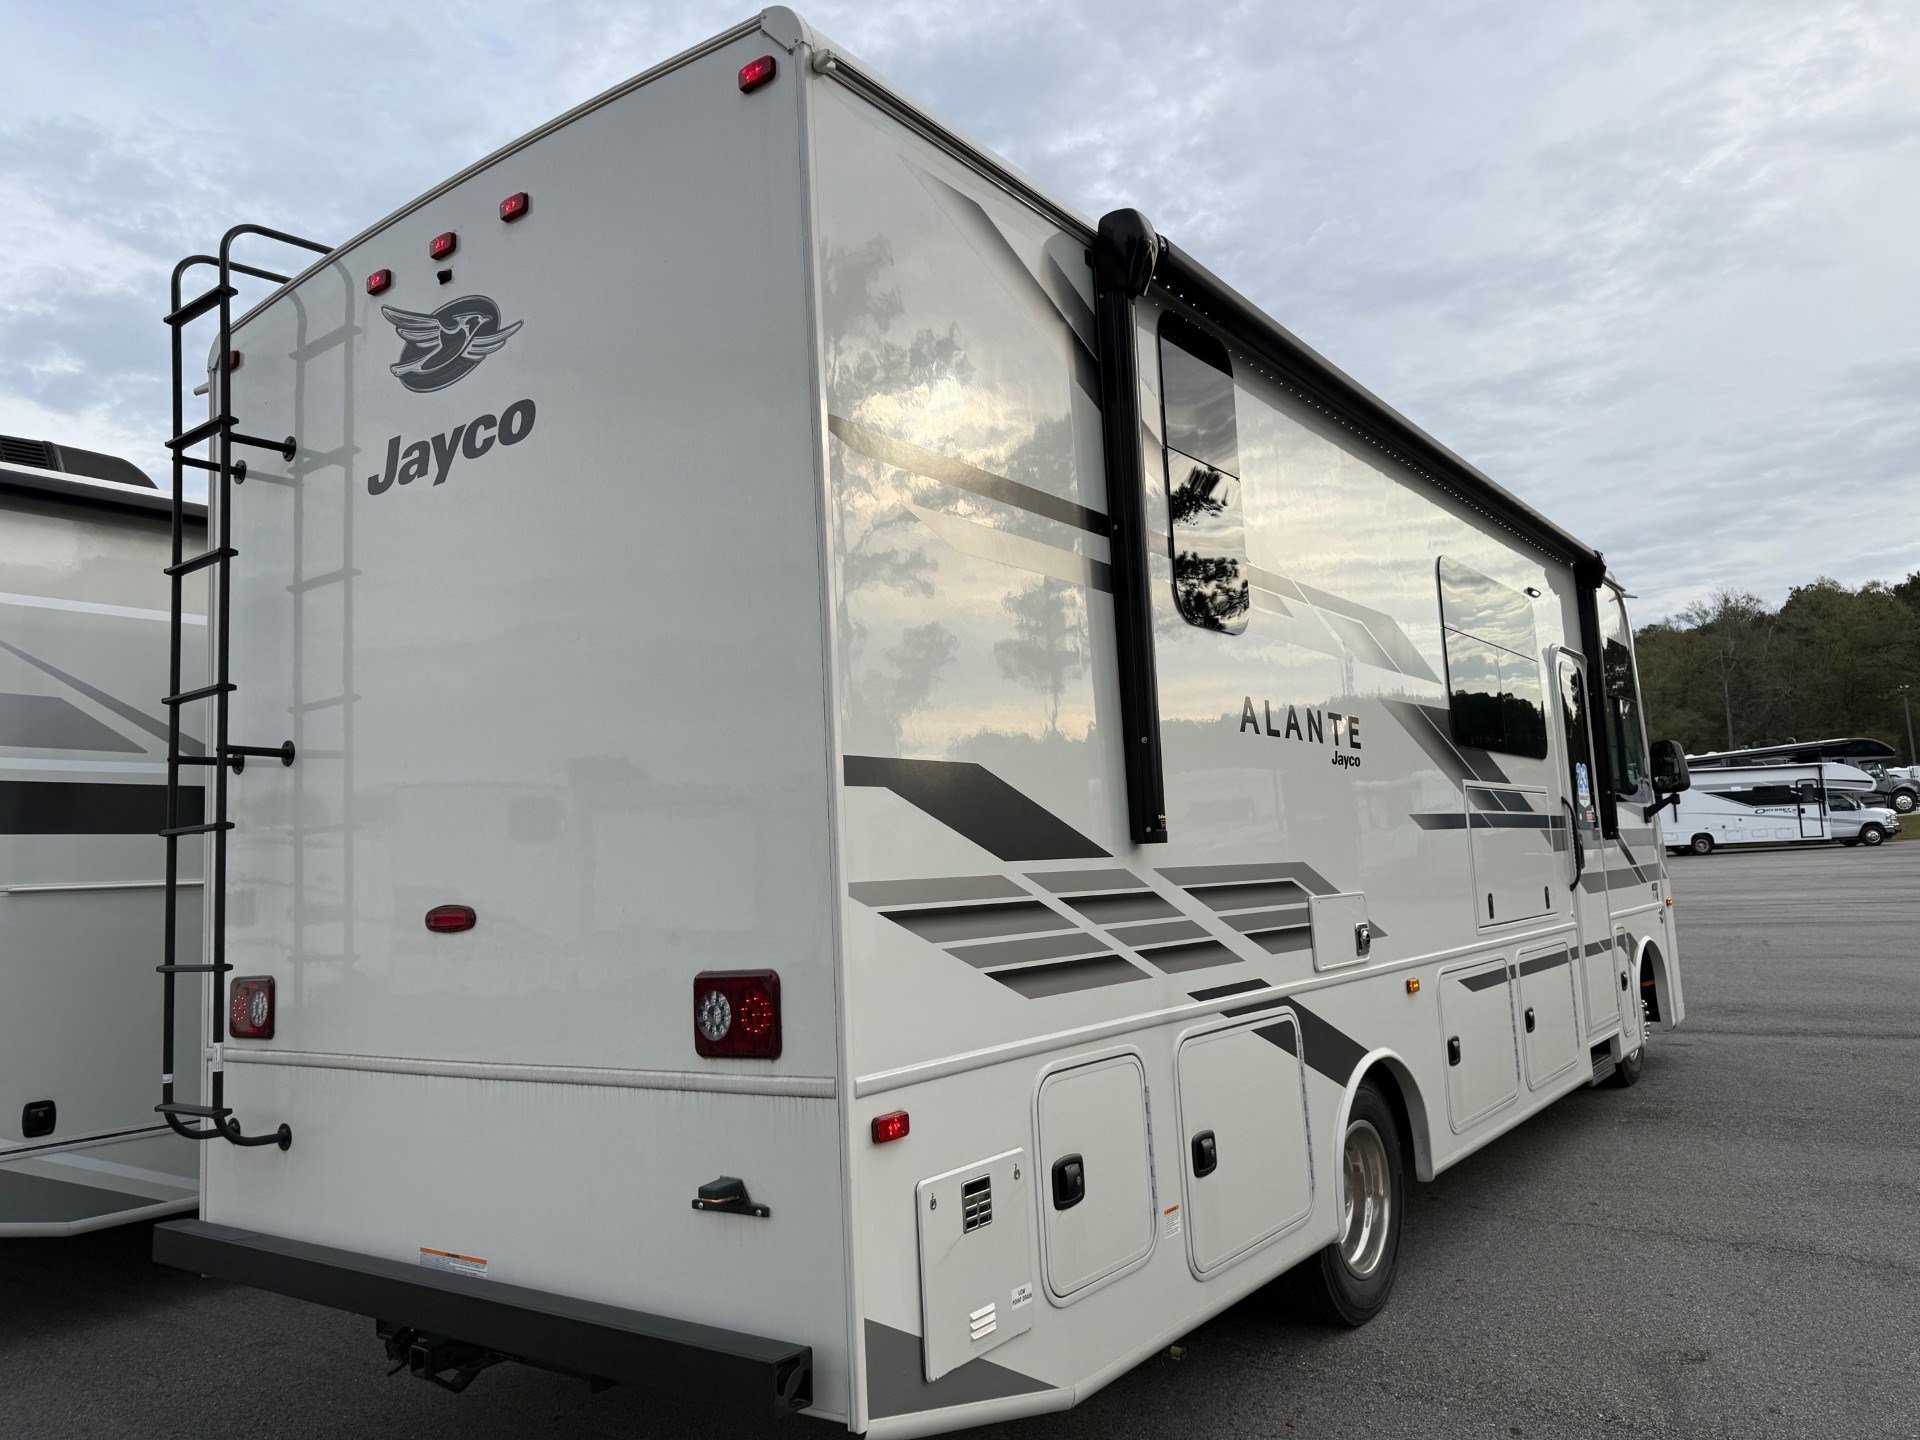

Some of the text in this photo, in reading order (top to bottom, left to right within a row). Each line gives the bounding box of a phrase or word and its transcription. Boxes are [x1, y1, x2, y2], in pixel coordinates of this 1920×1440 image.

[367, 398, 537, 496] Jayco
[1239, 695, 1362, 750] ALANTE
[1331, 750, 1361, 769] Jayco
